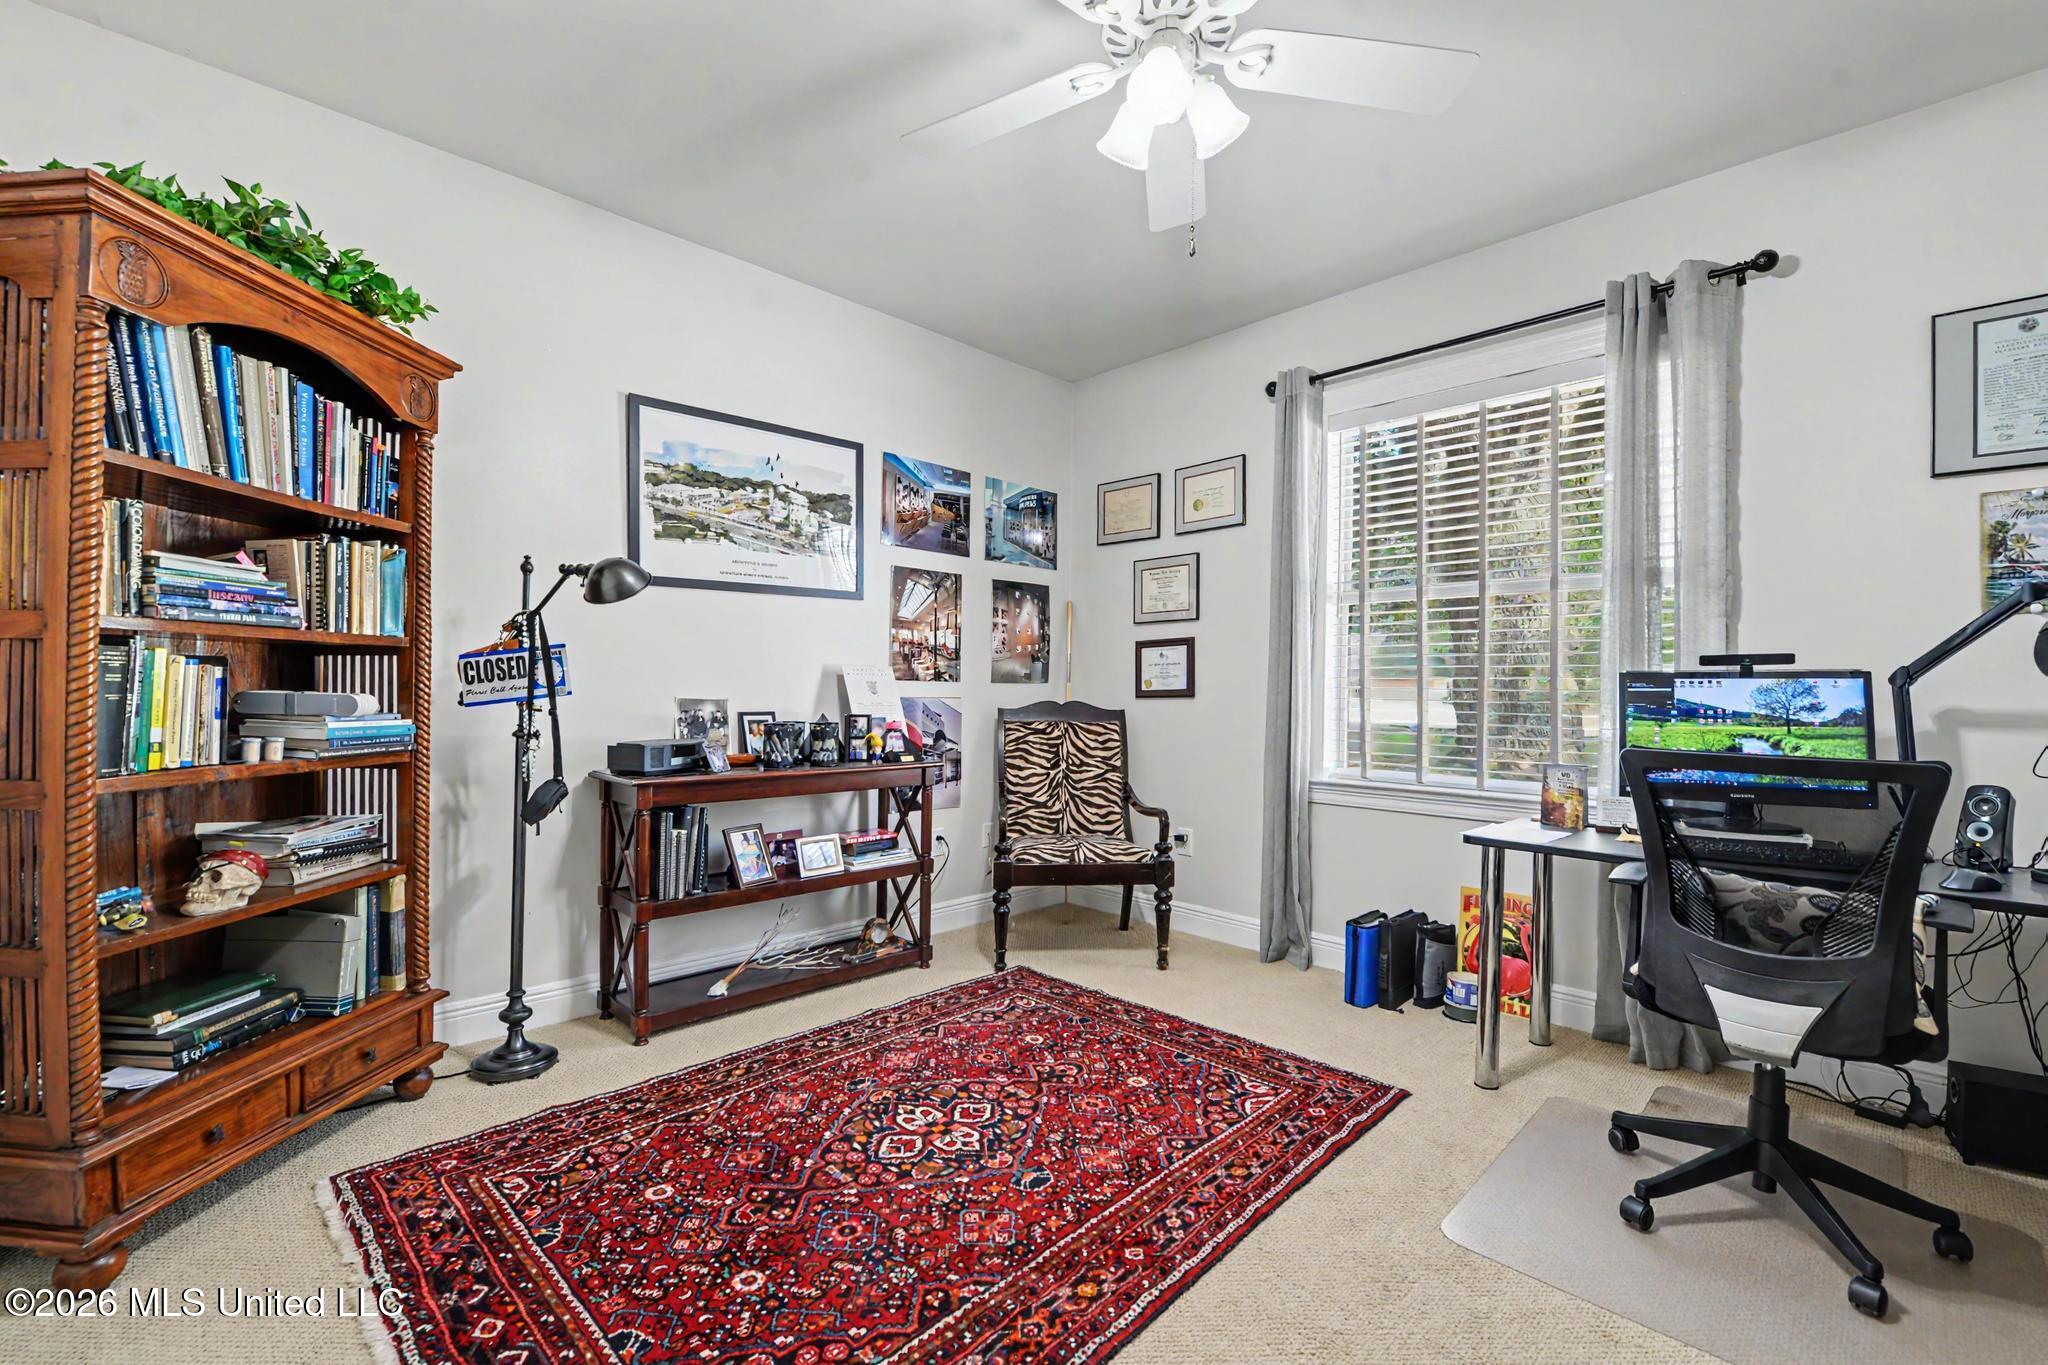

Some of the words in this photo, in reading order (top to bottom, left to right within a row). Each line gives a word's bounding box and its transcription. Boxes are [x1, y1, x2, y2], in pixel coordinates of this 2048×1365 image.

[141, 321, 155, 367] Architects
[151, 381, 168, 437] Architecture
[131, 508, 143, 542] COLOR
[131, 543, 143, 589] DRAWING
[464, 655, 528, 685] CLOSED
[490, 686, 505, 695] Call
